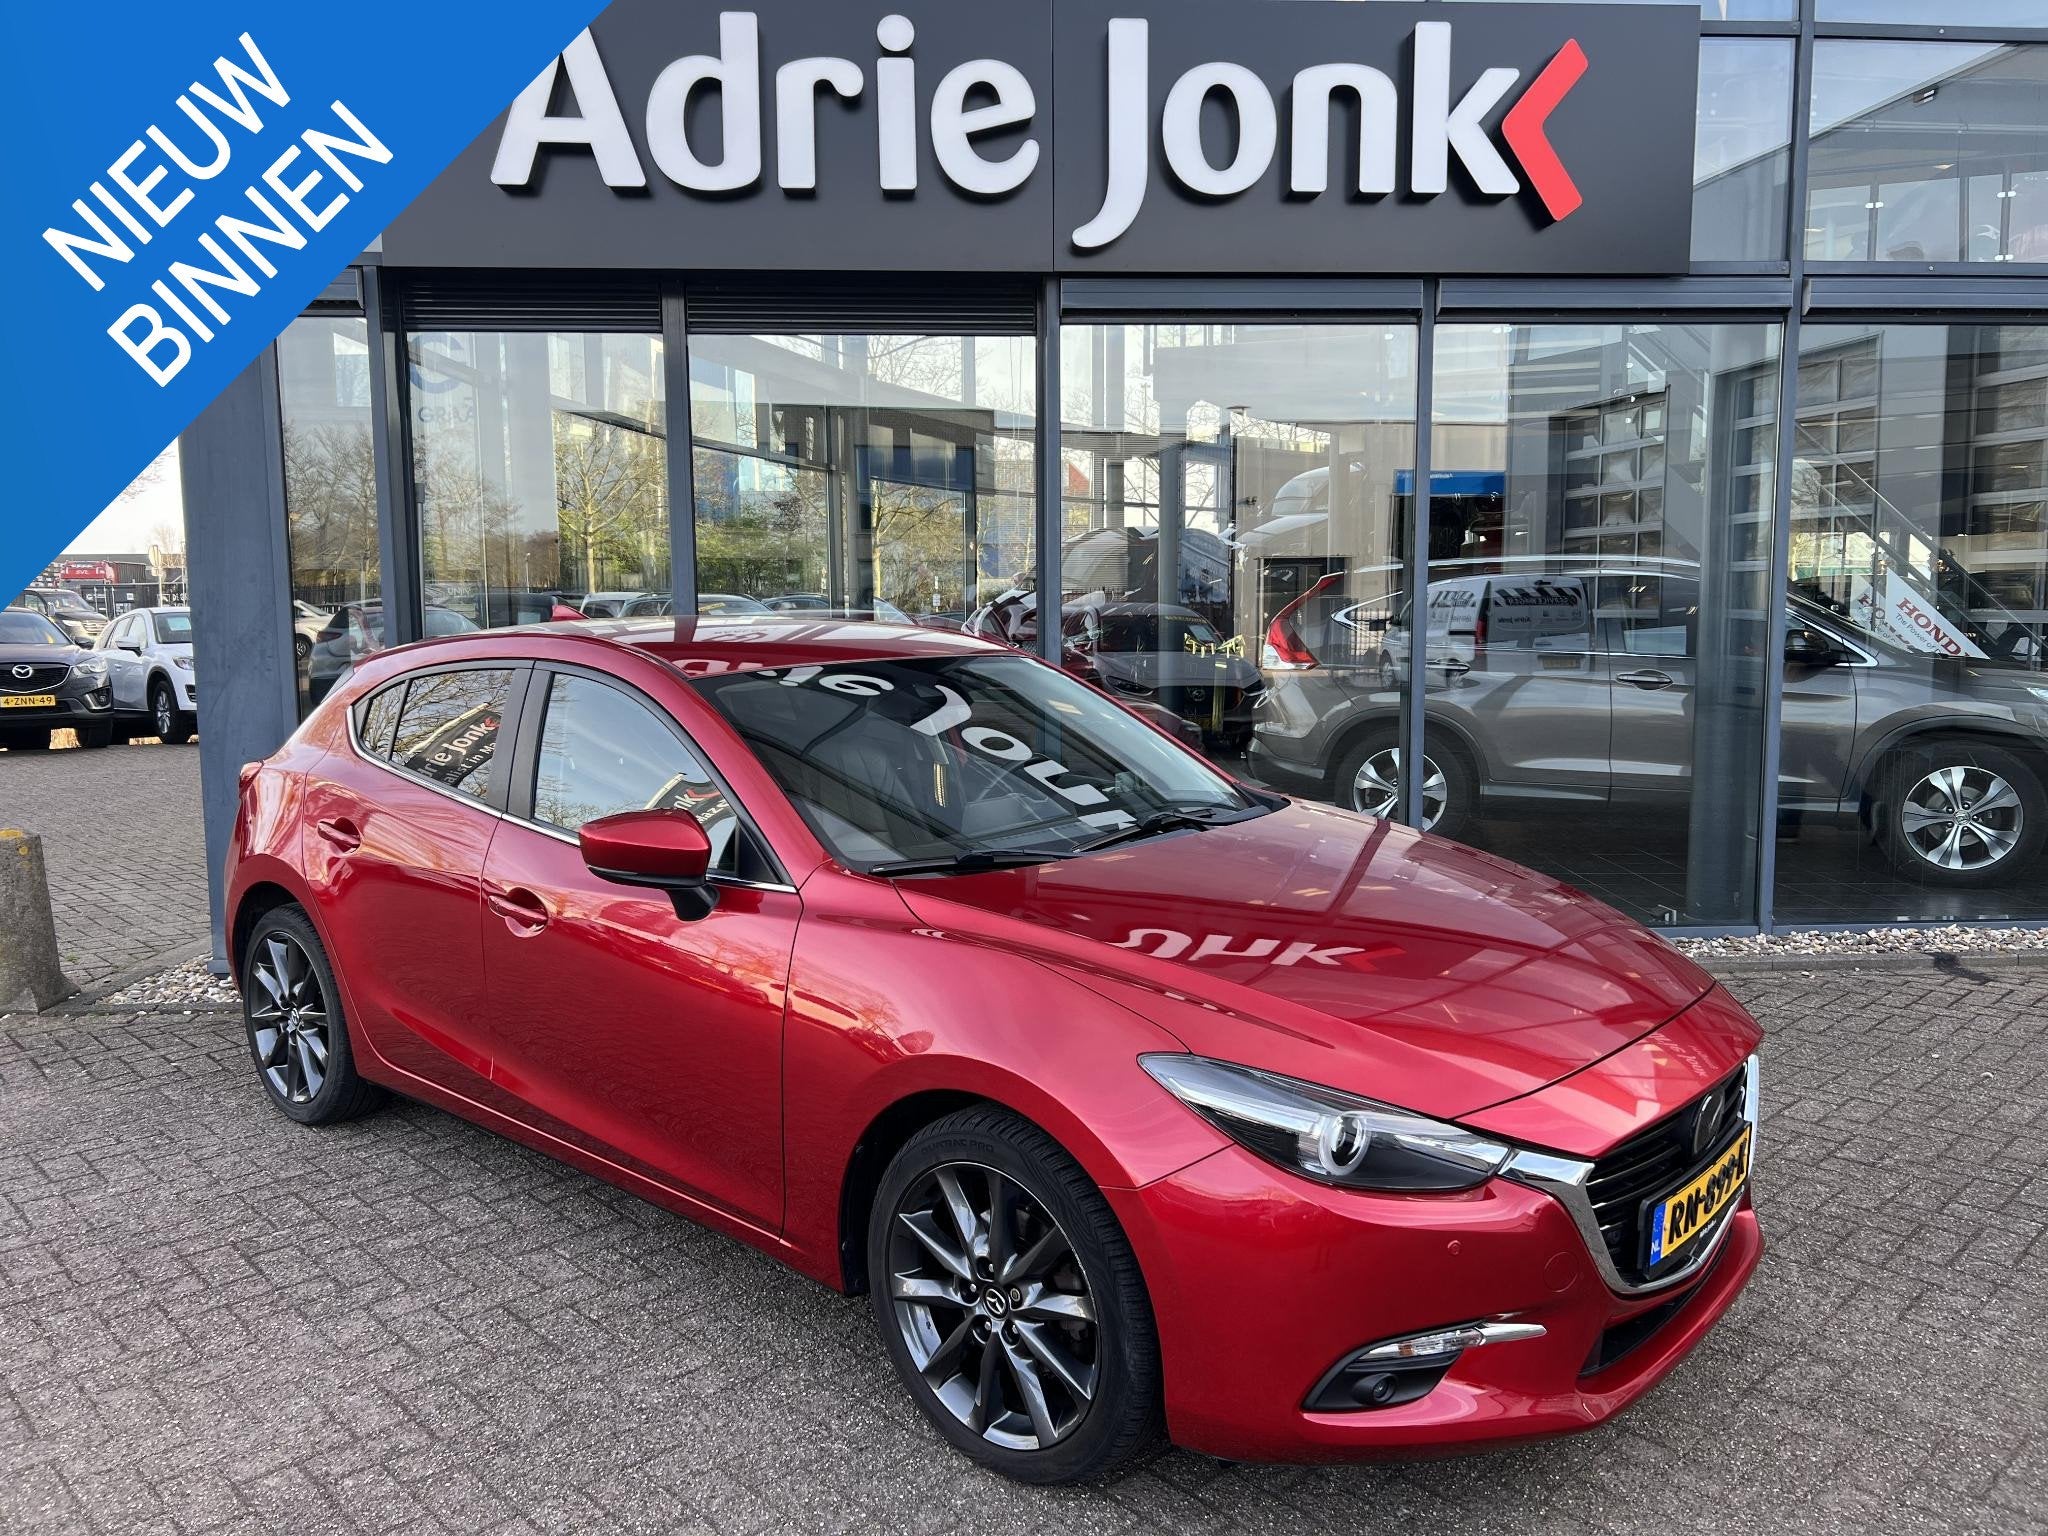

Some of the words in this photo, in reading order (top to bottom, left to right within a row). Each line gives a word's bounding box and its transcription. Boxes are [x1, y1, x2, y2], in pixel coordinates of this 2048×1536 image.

[489, 11, 1040, 194] Adrie
[1072, 18, 1521, 248] Jonk
[1896, 597, 1971, 657] HOND
[3, 696, 52, 706] 4-ZNN-49
[441, 722, 496, 756] Jonk
[1651, 1238, 1660, 1254] NL
